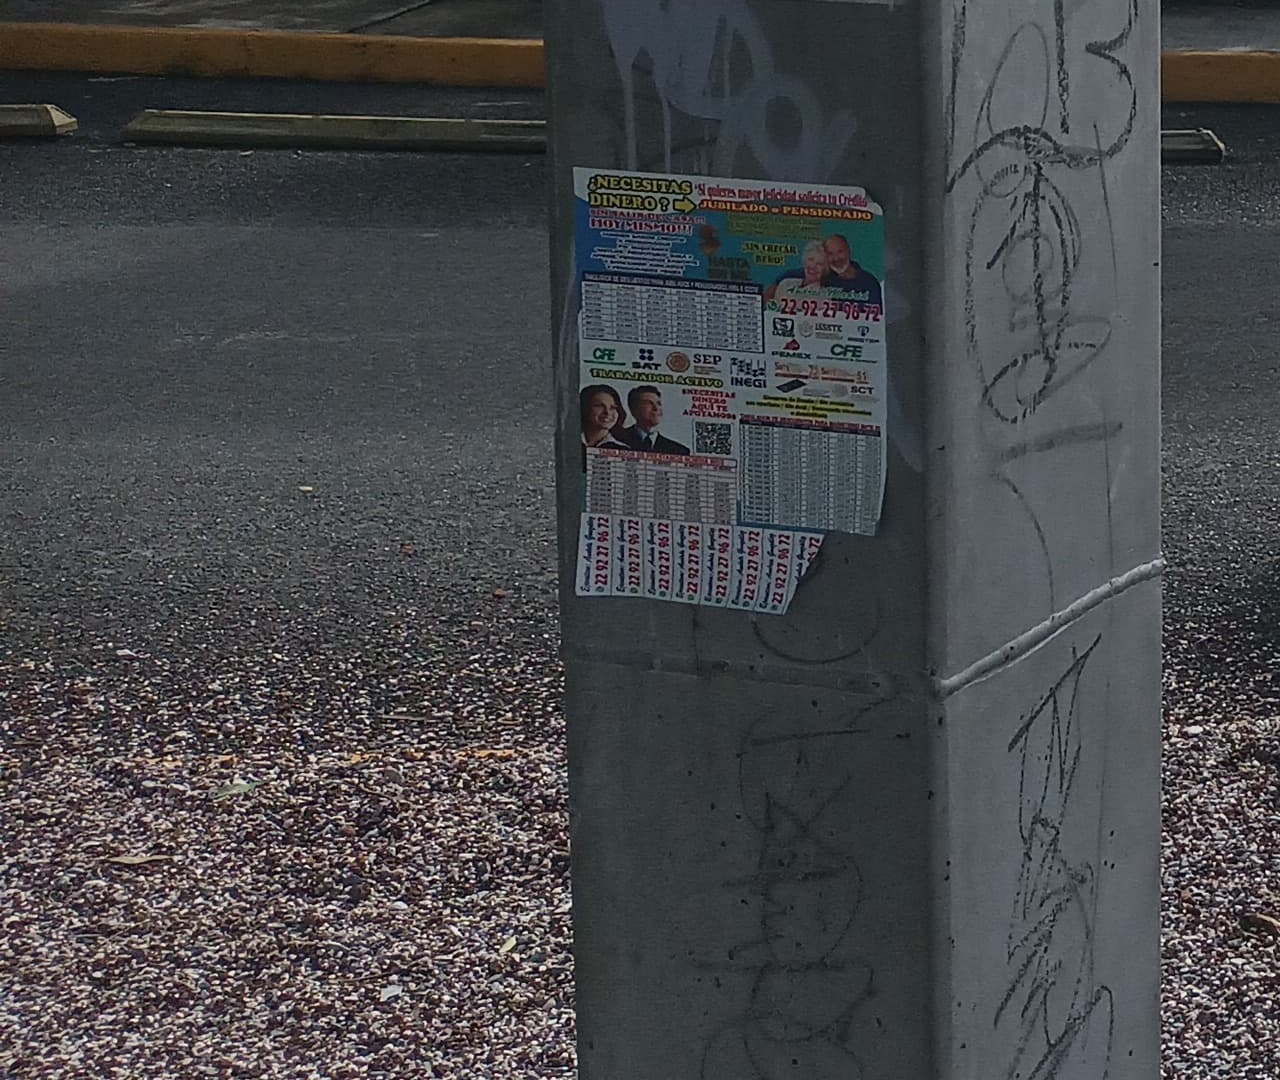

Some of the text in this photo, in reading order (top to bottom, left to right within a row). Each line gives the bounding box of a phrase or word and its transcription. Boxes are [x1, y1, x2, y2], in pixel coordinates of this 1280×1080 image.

[588, 175, 693, 195] ¿NECESITAS
[588, 192, 658, 212] DINERO
[699, 199, 769, 214] JUBILADO
[782, 204, 874, 221] PENSIONADO
[590, 219, 622, 230] HOY
[781, 298, 882, 322] 22 92 27 96 72
[592, 347, 617, 361] CFE
[693, 353, 722, 366] SEP
[830, 343, 863, 359] CFE
[632, 361, 662, 371] SAT
[590, 368, 725, 389] TRABAJADOR ACTIVO
[731, 377, 767, 390] INEGI
[594, 517, 609, 586] 22 92 27 96 72
